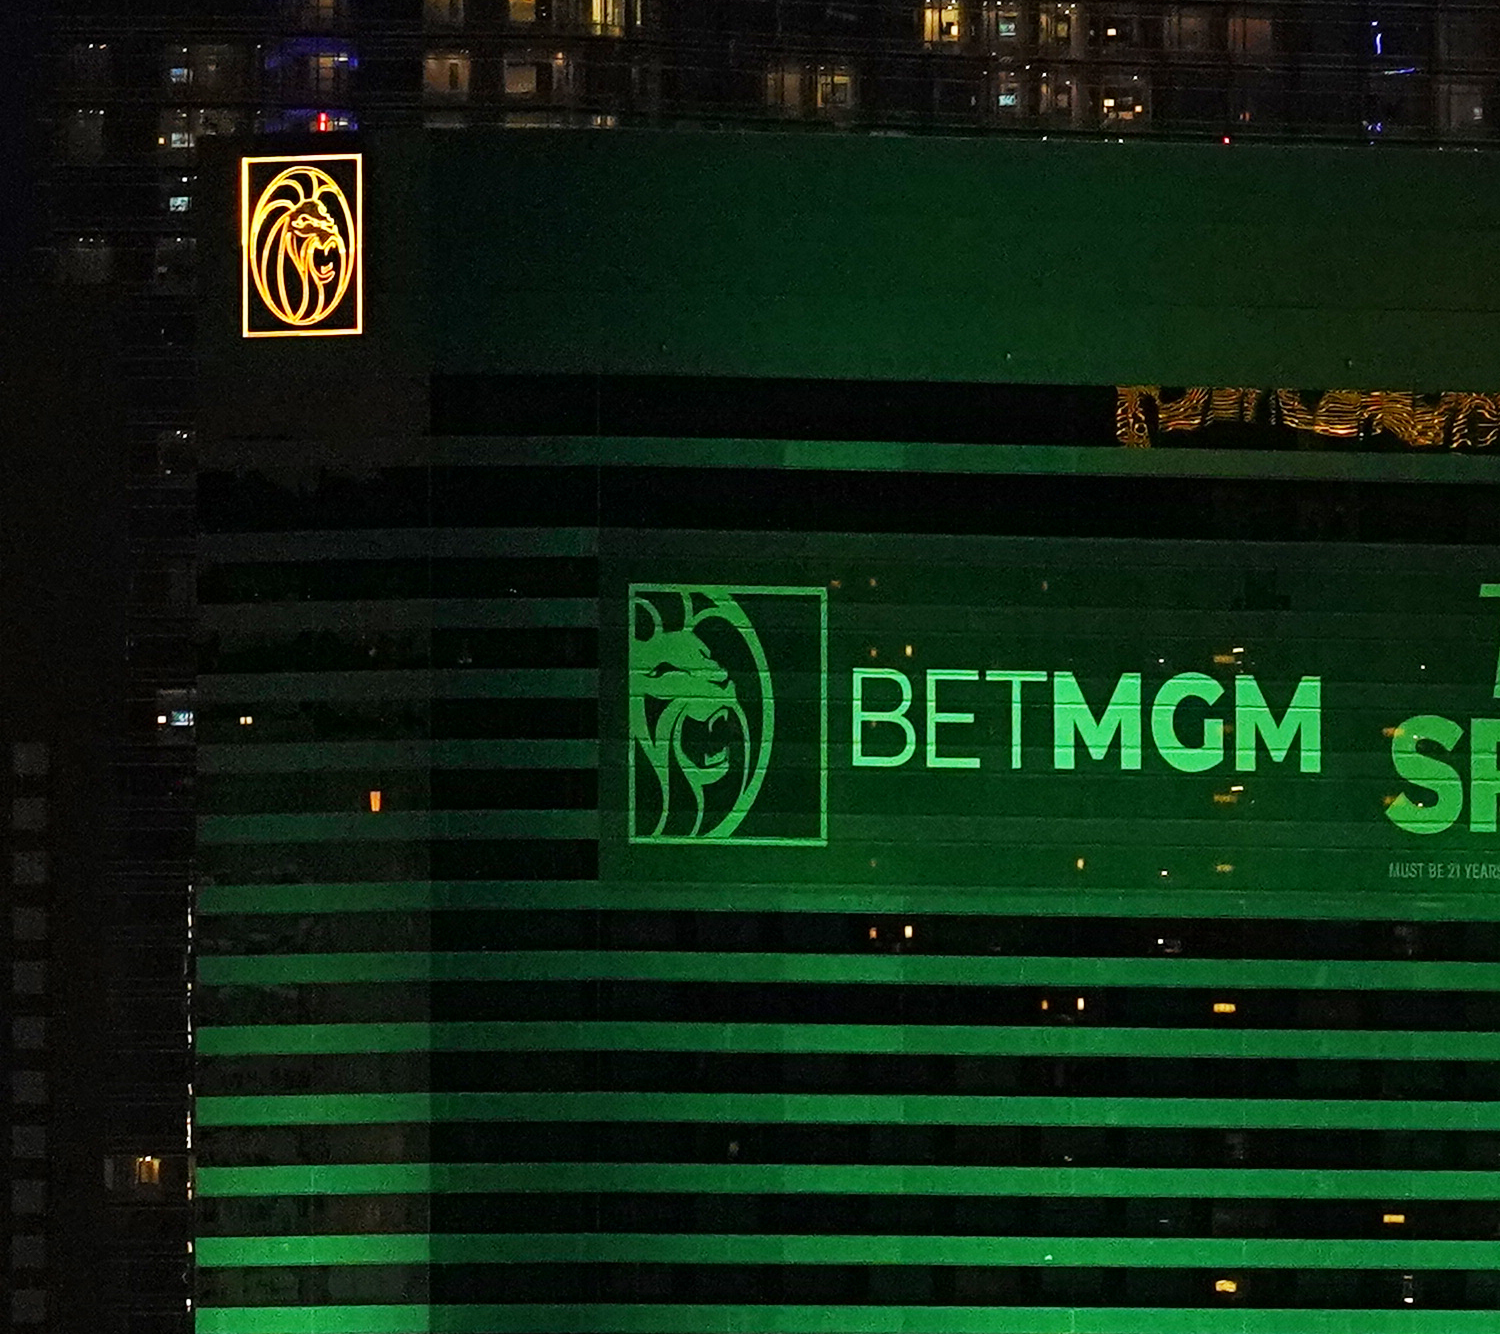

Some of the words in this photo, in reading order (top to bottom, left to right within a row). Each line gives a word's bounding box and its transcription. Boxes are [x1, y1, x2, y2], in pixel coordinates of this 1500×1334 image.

[851, 667, 1322, 774] BETMGM
[1389, 862, 1424, 878] MUST
[1428, 863, 1444, 878] BE
[1447, 863, 1461, 878] 21
